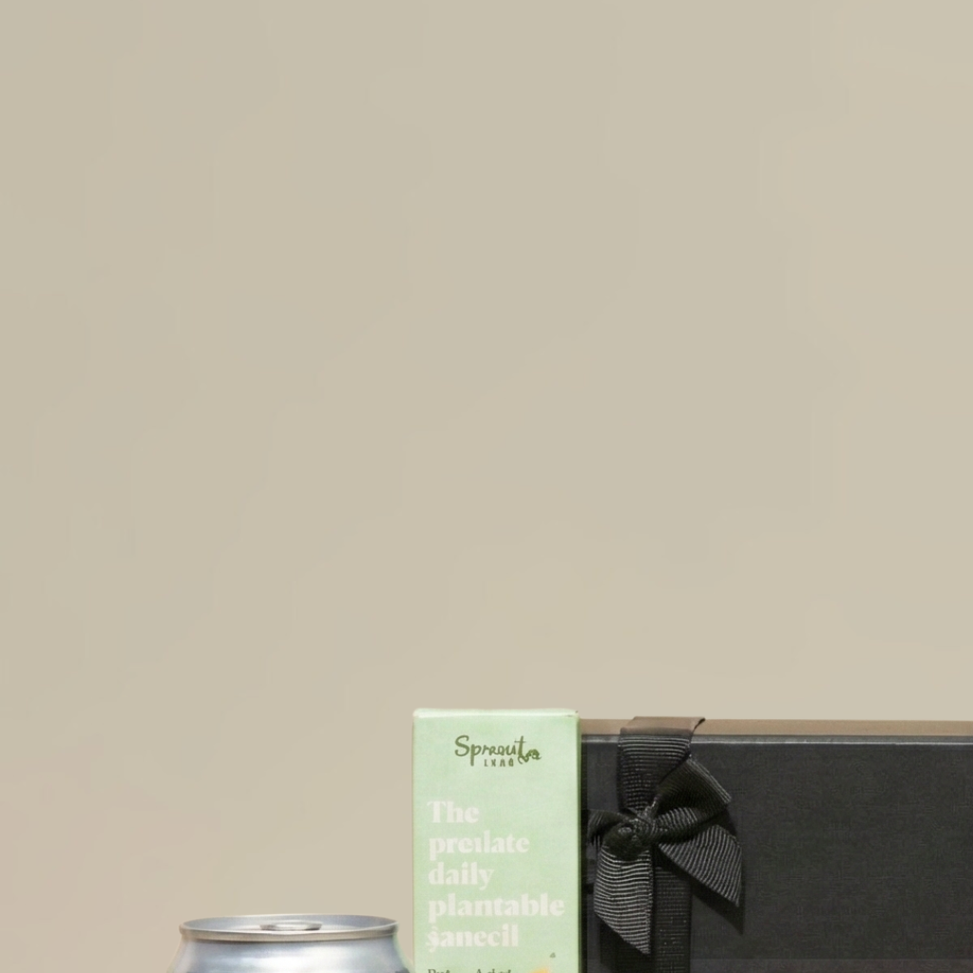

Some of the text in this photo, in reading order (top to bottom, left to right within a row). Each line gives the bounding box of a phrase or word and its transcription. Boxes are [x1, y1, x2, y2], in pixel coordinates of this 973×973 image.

[427, 801, 480, 823] The
[428, 862, 494, 890] daily
[428, 893, 565, 923] plantable
